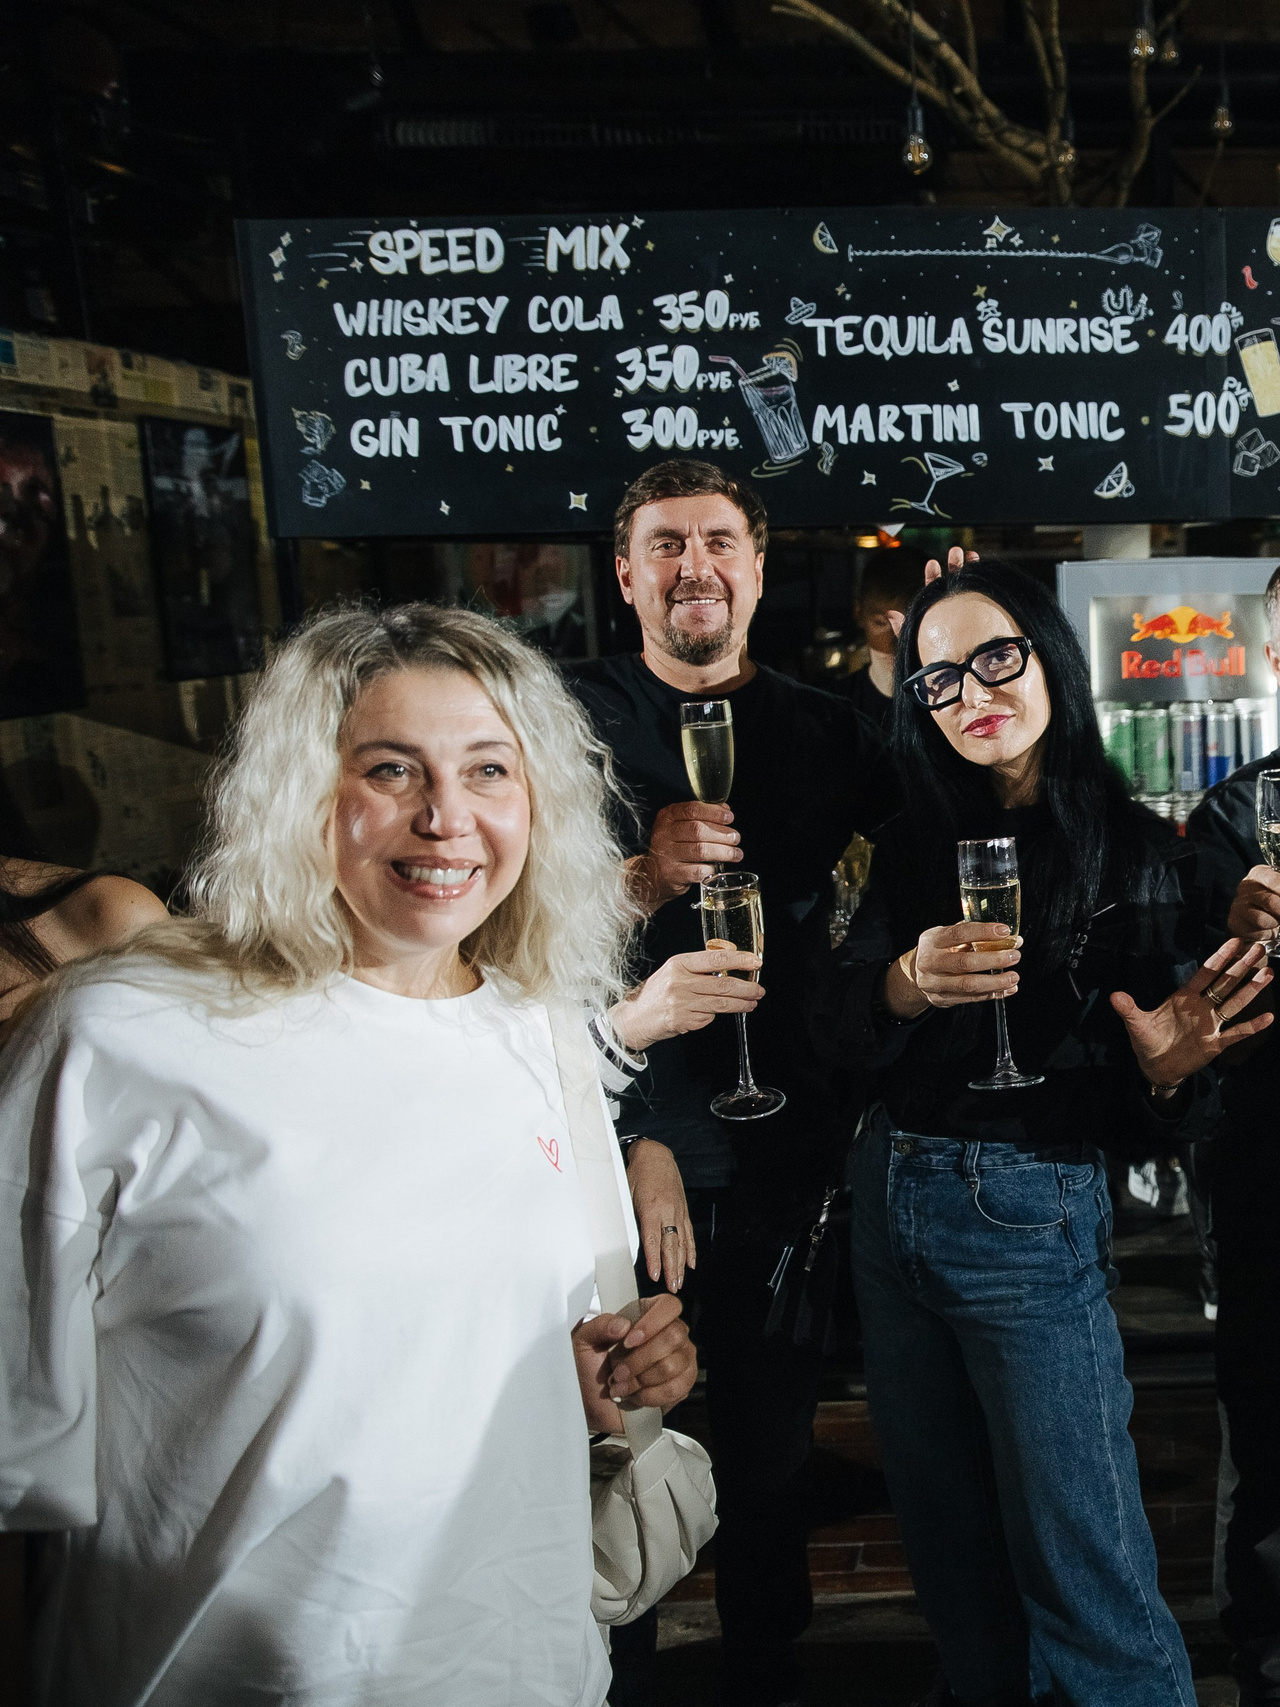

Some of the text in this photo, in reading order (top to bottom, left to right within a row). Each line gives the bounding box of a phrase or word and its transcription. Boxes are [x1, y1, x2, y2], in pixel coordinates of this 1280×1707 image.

[368, 223, 631, 274] SPEED MIX
[333, 296, 510, 337] WHISKEY
[527, 294, 624, 334] COLA
[652, 289, 730, 332] 350
[803, 315, 971, 361] TEQUILA
[981, 315, 1140, 355] SUNRISE
[1164, 313, 1232, 356] 400
[344, 352, 450, 398] CUBA
[468, 353, 579, 394] LIBRE
[614, 344, 699, 393] 350
[350, 417, 419, 458] GIN
[438, 416, 562, 453] TONIC
[621, 406, 698, 449] 300
[811, 403, 981, 445] MARTINI
[1000, 401, 1126, 443] TONIC
[1163, 391, 1240, 437] 500
[1121, 646, 1246, 679] Red Bull
